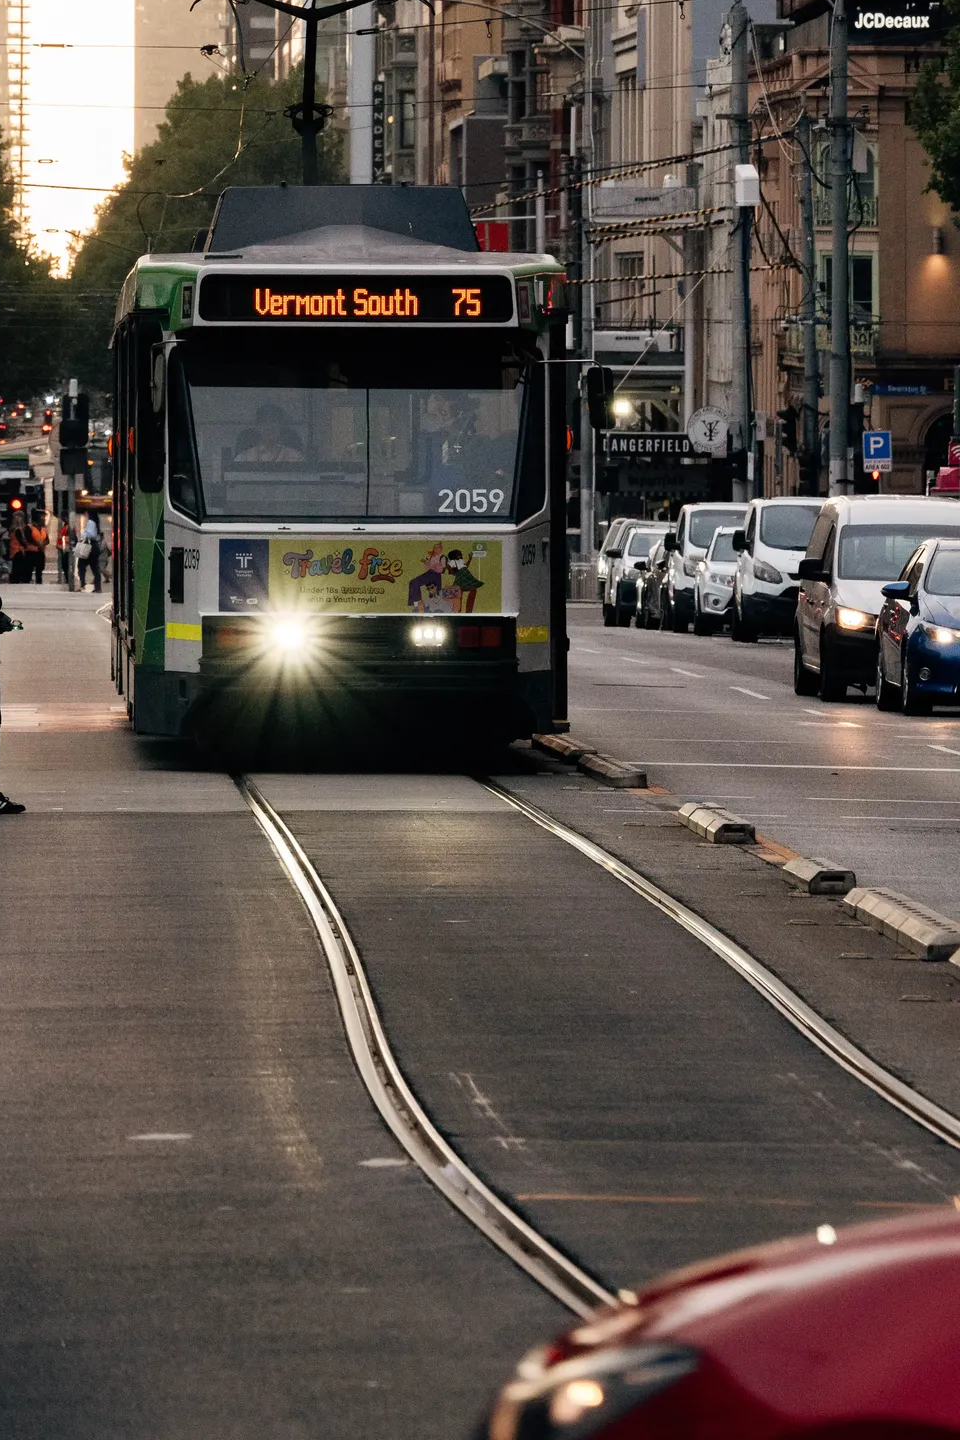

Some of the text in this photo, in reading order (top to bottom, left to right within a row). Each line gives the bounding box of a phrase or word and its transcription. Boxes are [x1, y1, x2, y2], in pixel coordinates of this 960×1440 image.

[854, 12, 930, 29] JCDecaux
[254, 288, 482, 316] Vermont South 75
[869, 436, 884, 456] P
[438, 488, 505, 513] 2059
[184, 548, 200, 570] 2059
[282, 548, 356, 579] Travel
[521, 544, 536, 566] 2059
[299, 586, 324, 594] Under
[325, 586, 338, 594] 18s
[341, 586, 367, 594] travel
